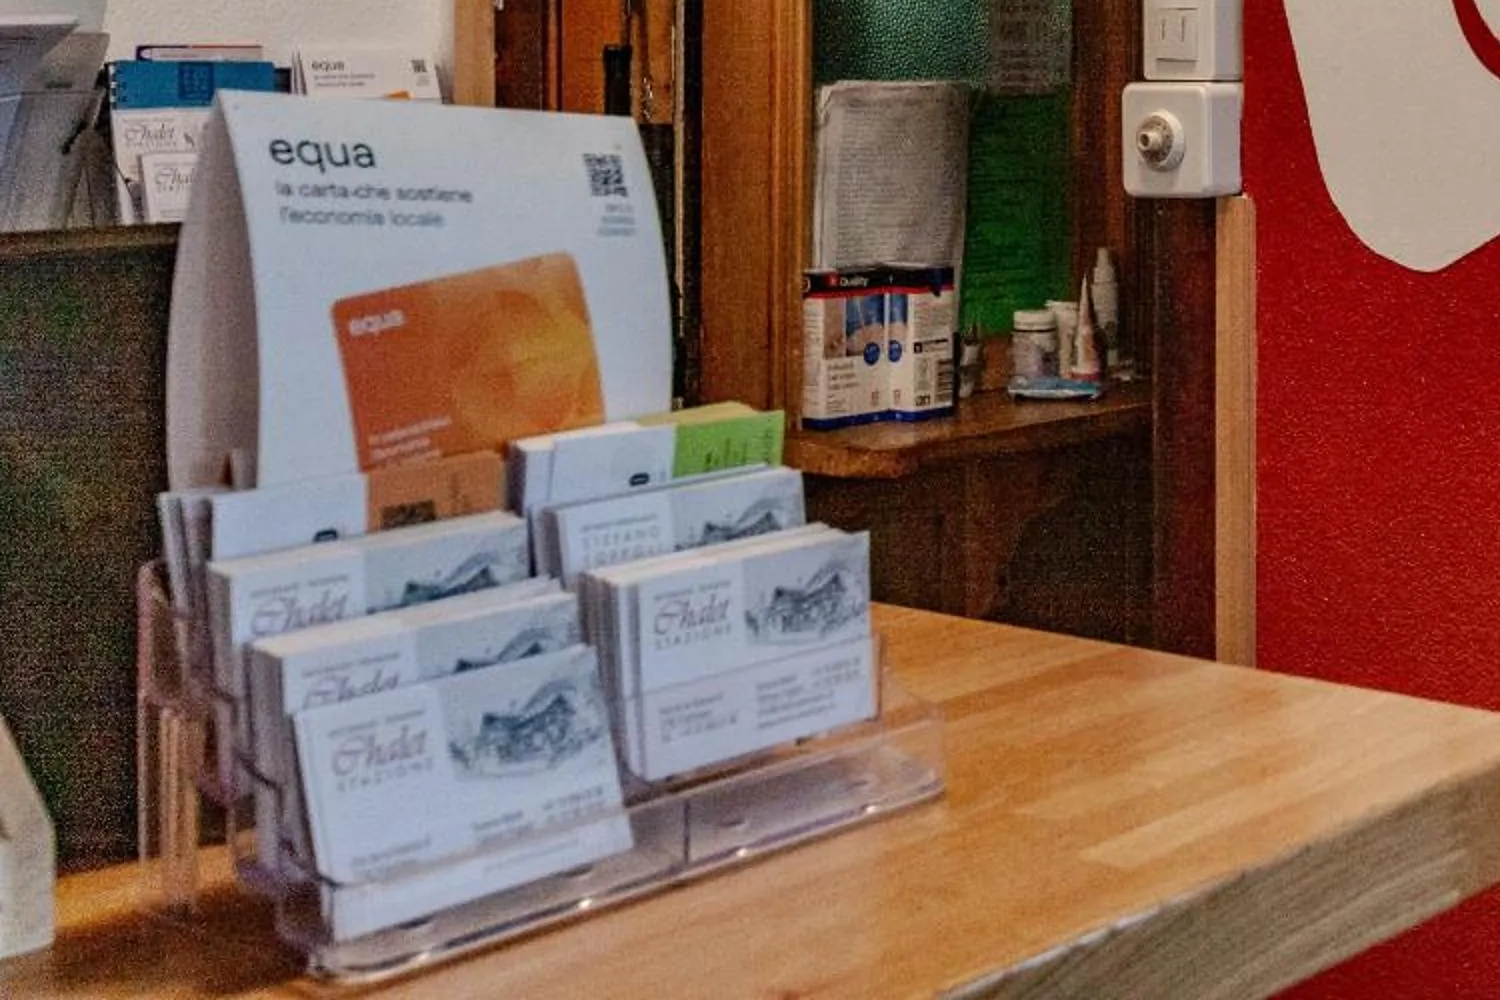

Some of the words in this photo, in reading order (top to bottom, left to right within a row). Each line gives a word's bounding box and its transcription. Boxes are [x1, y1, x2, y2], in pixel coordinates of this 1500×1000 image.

[268, 138, 377, 174] equa
[298, 183, 349, 198] carta
[348, 308, 406, 339] equa
